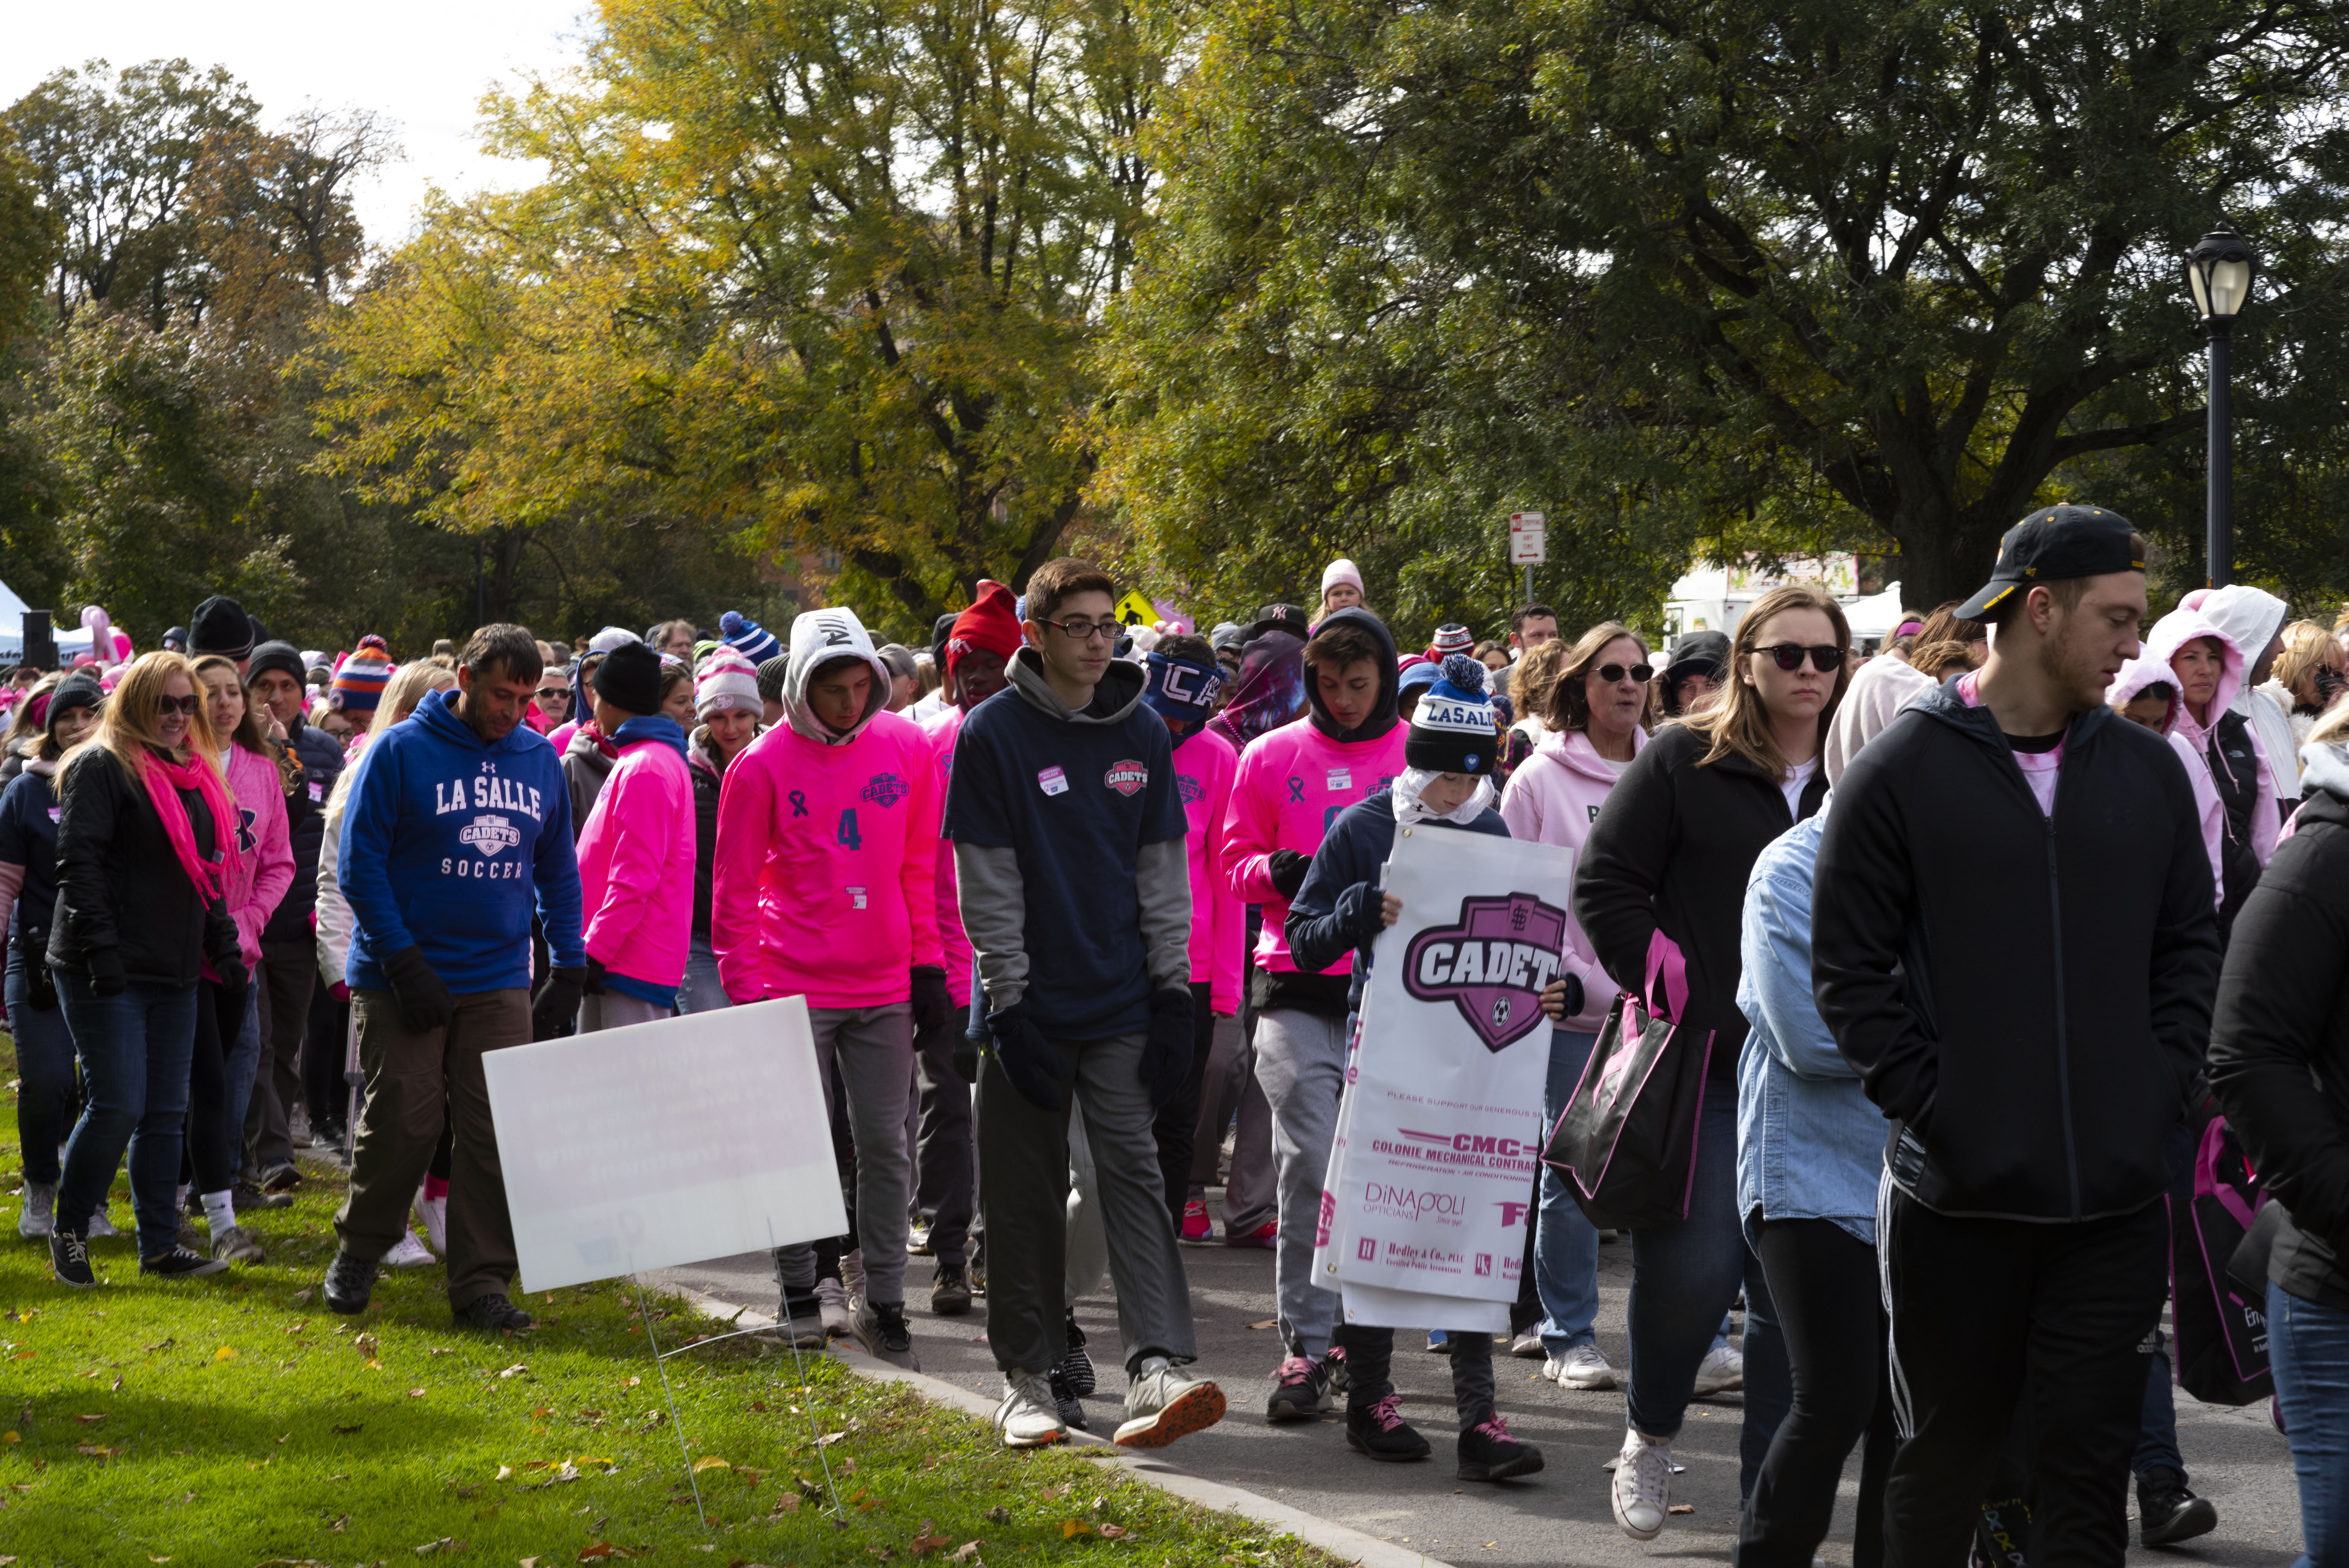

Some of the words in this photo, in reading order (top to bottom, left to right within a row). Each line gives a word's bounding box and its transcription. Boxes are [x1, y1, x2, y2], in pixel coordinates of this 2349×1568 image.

[1512, 519, 1521, 528] NO
[1449, 634, 1465, 645] RED
[1428, 704, 1494, 727] LASALL
[1108, 770, 1148, 785] CADETS
[436, 779, 467, 816] LA
[474, 776, 541, 823] SALLE
[863, 783, 907, 800] CADETS
[463, 827, 517, 844] CADETS
[837, 808, 863, 851] 4
[441, 858, 521, 879] SOCCER
[1420, 941, 1562, 993] CADET
[1387, 1090, 1424, 1103] PLEASE
[1427, 1098, 1468, 1110] SUPPORT
[1485, 1105, 1529, 1117] GENEROUS
[1372, 1139, 1422, 1158] COLONIE
[1426, 1148, 1485, 1167] MECHANICAL
[1489, 1156, 1535, 1172] CONTRAC
[1453, 1133, 1520, 1156] CMC
[1388, 1158, 1455, 1175] REFRIGERATION
[1476, 1171, 1531, 1183] CONDITIONING
[1363, 1203, 1413, 1221] OPTICIANS
[1389, 1241, 1419, 1260] Hedley
[1421, 1249, 1427, 1260] &
[1430, 1247, 1445, 1262] Co.,
[1448, 1252, 1465, 1264] PLLC
[1386, 1257, 1410, 1268] Certified
[1412, 1260, 1428, 1271] Public
[1430, 1263, 1461, 1274] Accountants
